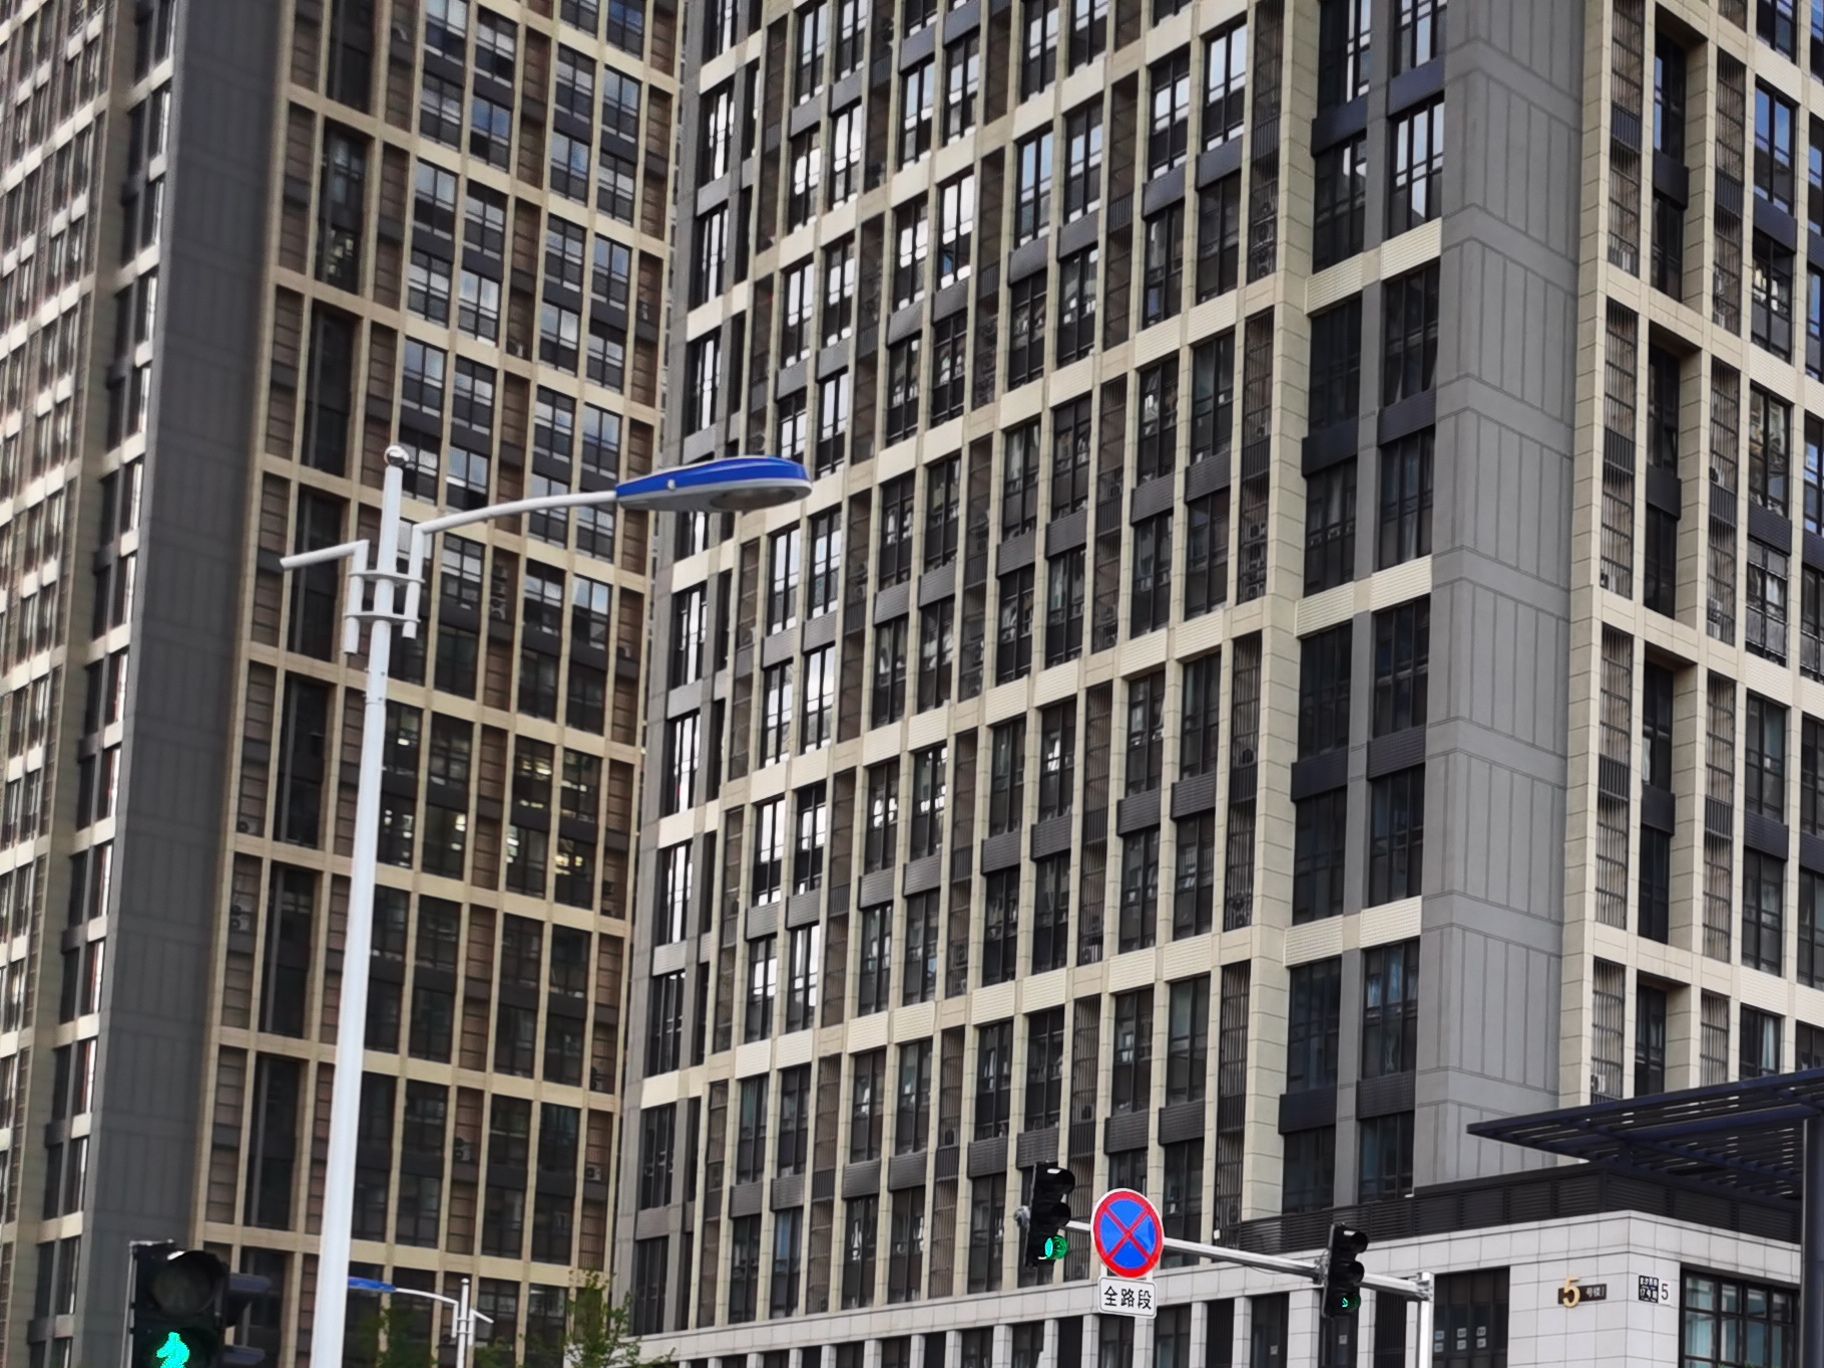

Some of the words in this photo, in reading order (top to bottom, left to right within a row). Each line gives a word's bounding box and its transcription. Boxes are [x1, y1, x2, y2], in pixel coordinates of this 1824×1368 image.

[1104, 1285, 1152, 1310] 全路段
[1661, 1283, 1669, 1300] 5
